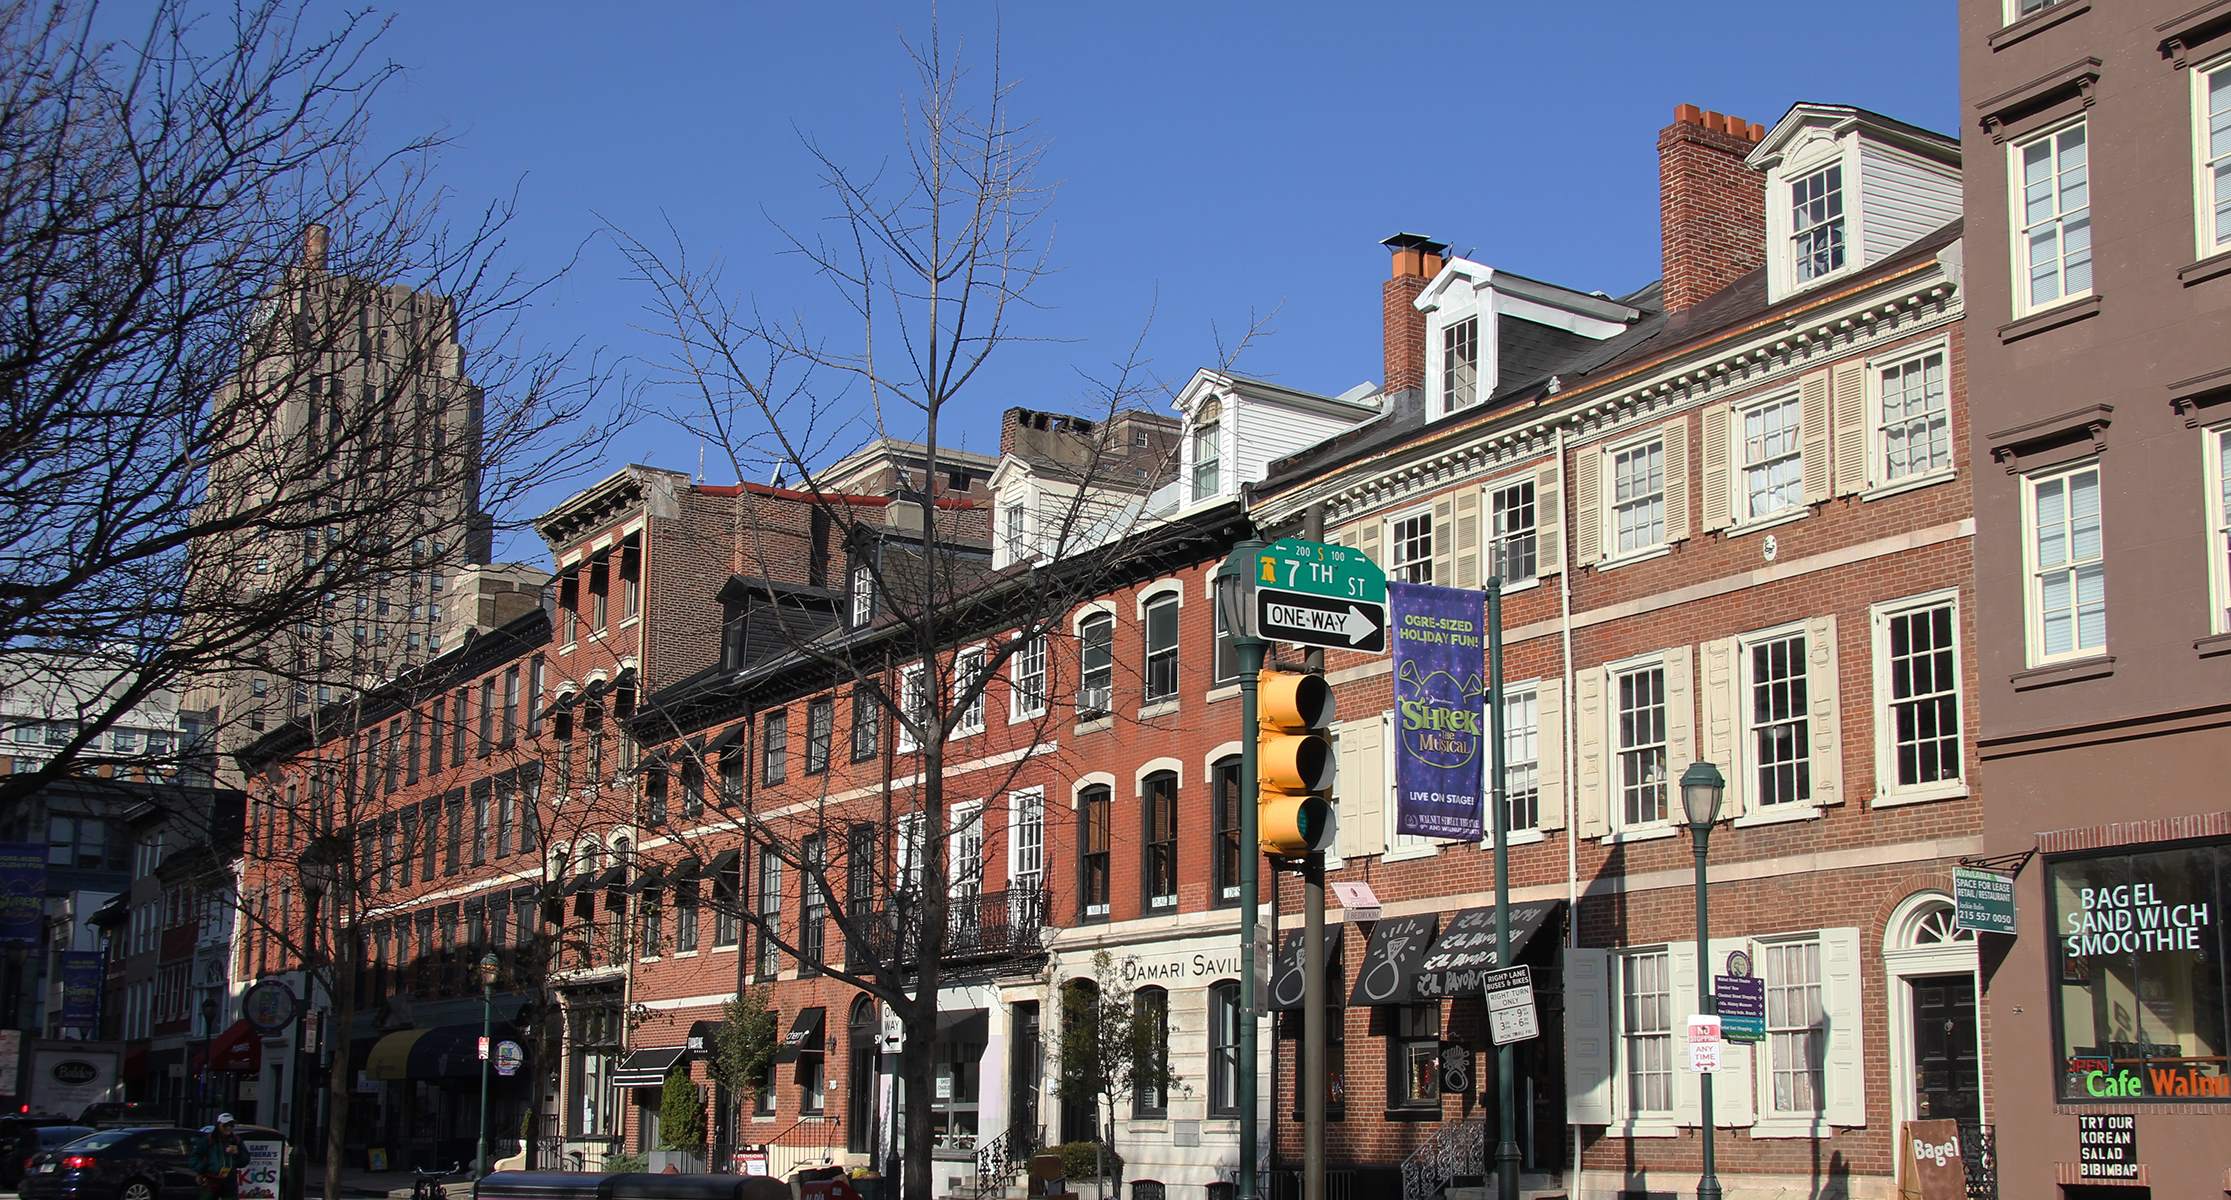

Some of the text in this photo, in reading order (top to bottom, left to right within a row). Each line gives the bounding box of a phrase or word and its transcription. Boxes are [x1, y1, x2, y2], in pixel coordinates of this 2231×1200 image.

[1296, 546, 1345, 561] 200 S 100
[1348, 577, 1365, 597] ST
[1272, 606, 1347, 632] ONE WAY
[1404, 614, 1473, 632] OGRE-SIZED
[1400, 628, 1478, 648] HOLIDAY FUN!
[1410, 791, 1474, 806] LIVE ON STAGE!
[1956, 878, 2011, 893] SPACE FOR LEASE
[2081, 883, 2162, 910] BAGEL
[1959, 910, 2011, 924] 215 557 0050
[2068, 927, 2200, 957] SMOOTHIE
[1192, 954, 1241, 977] SAVIL
[1487, 969, 1526, 983] RIGHT LANE
[1487, 981, 1506, 991] BUSES
[1512, 976, 1529, 985] BIKES
[1489, 988, 1529, 1001] RIGHT TURN
[1502, 997, 1519, 1006] ONLY
[884, 1020, 899, 1030] WAY
[1697, 1025, 1710, 1035] NO
[1696, 1045, 1713, 1053] ANY
[1696, 1053, 1716, 1061] TIME
[2086, 1069, 2142, 1097] Cafe
[2080, 1116, 2133, 1129] TRY OUR
[2081, 1131, 2130, 1144] KOREAN
[1913, 1136, 1960, 1167] Bagel
[2082, 1147, 2123, 1160] SALAD
[2081, 1163, 2138, 1176] BIBIMBAP
